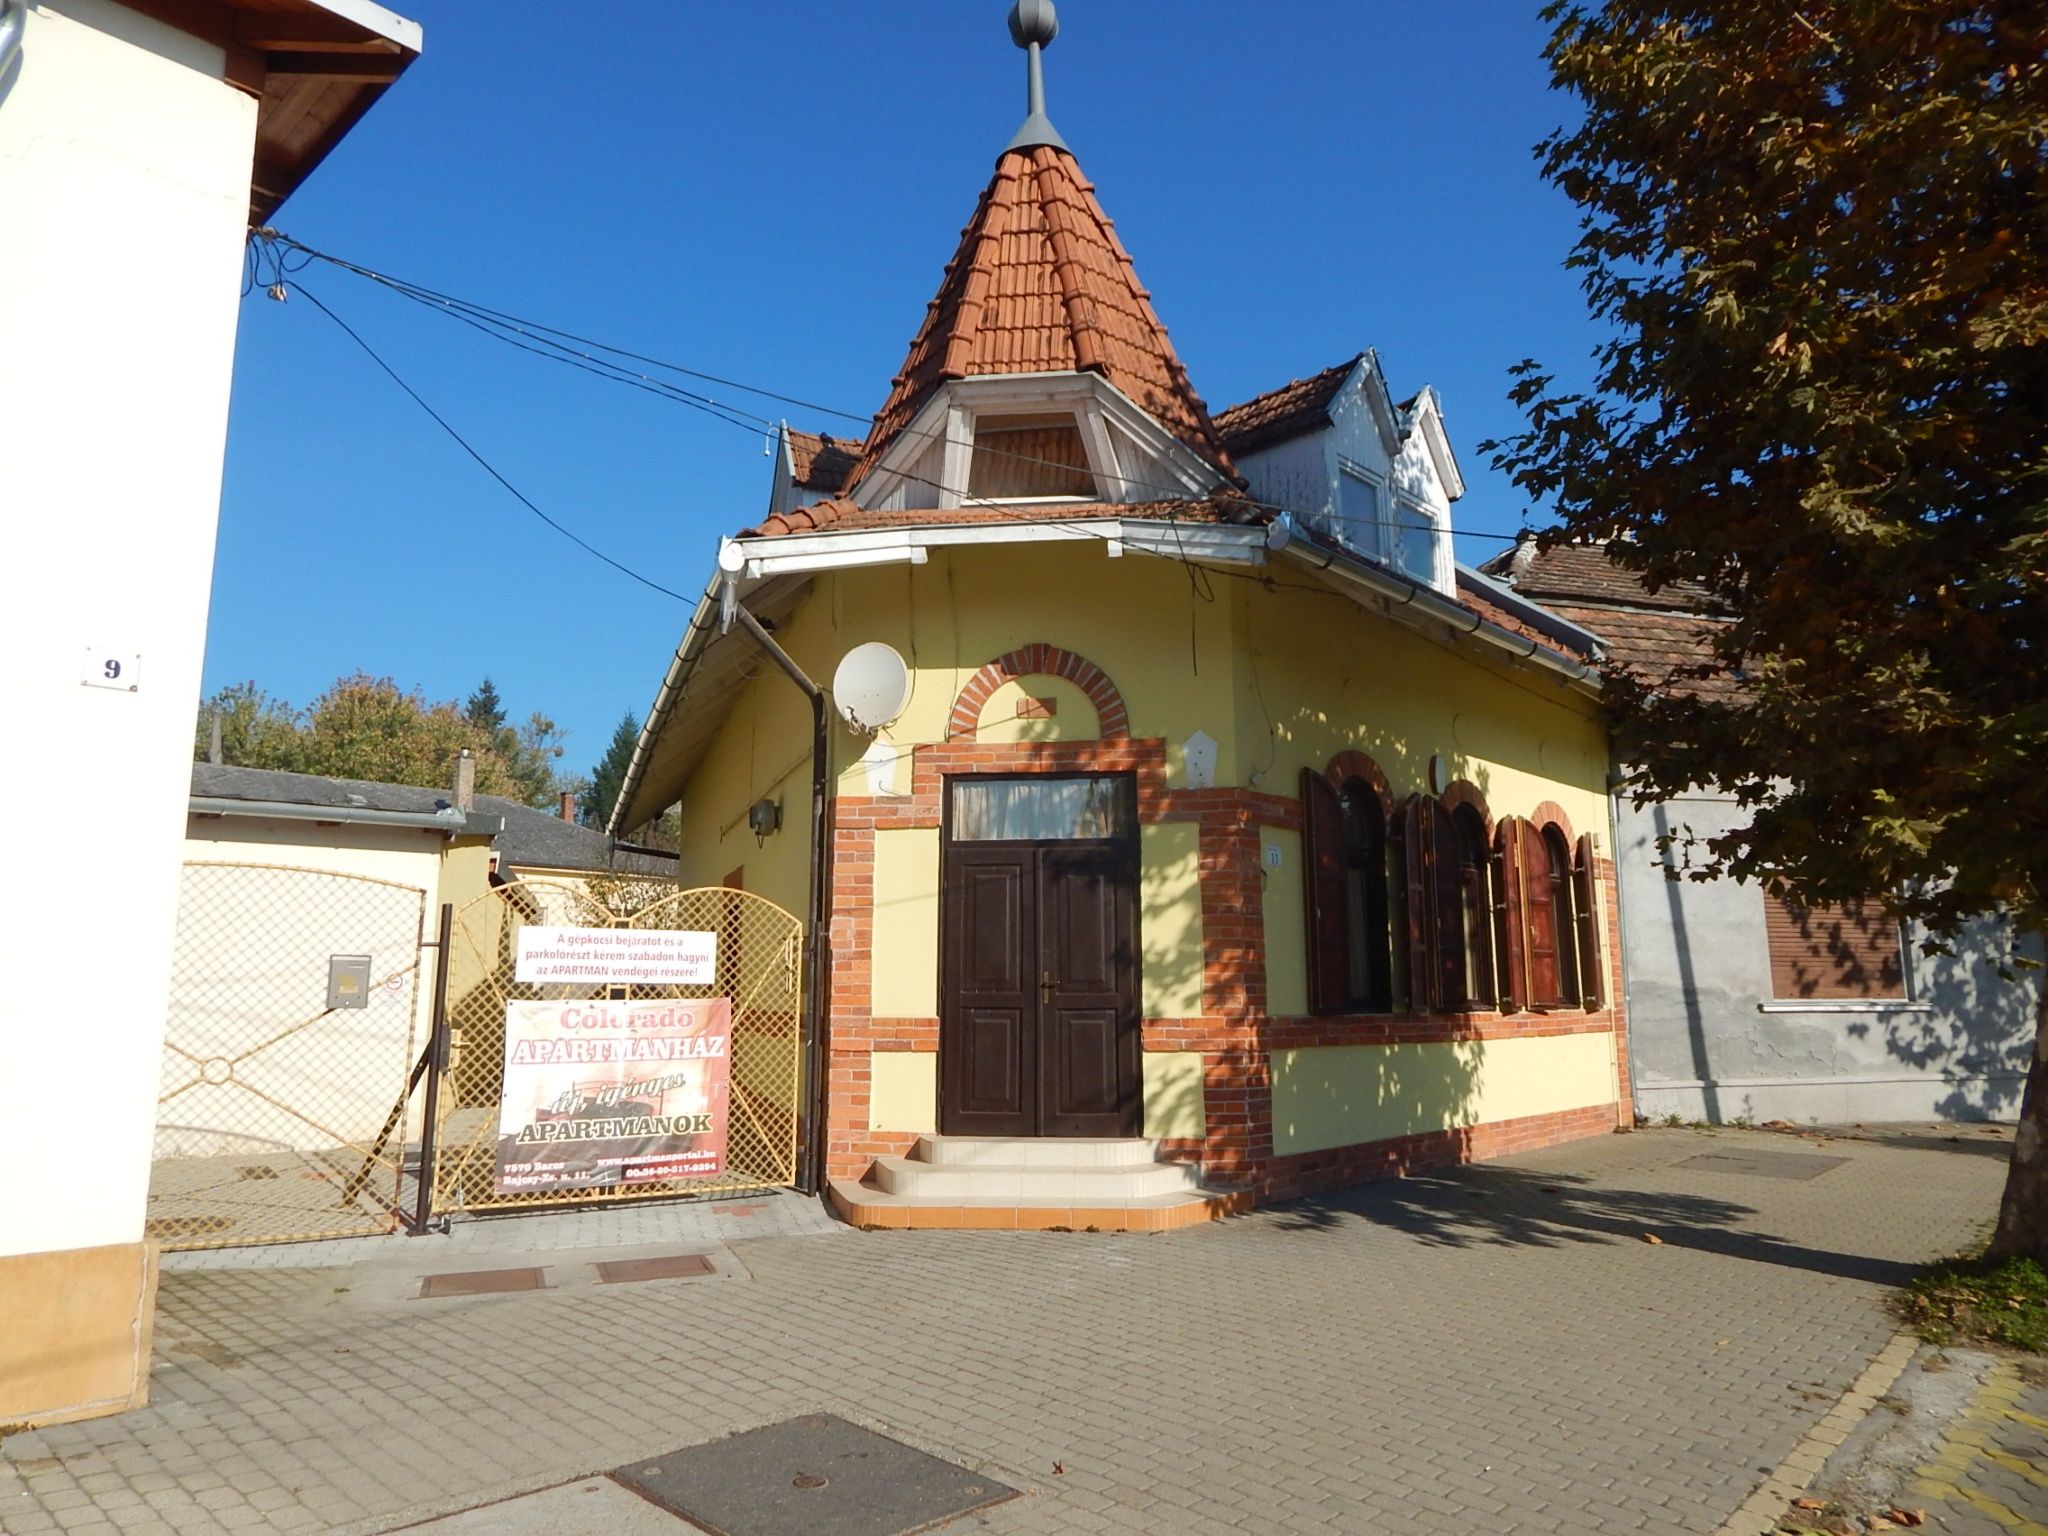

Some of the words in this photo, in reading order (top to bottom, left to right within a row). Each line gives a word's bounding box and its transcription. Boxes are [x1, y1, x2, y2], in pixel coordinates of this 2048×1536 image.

[104, 659, 121, 679] 9
[1270, 852, 1279, 865] 11
[557, 933, 565, 943] A
[568, 933, 613, 946] gépkocsi
[616, 935, 661, 948] bejáratot
[664, 936, 674, 946] és
[677, 938, 683, 946] a
[593, 950, 625, 960] kérem
[628, 951, 675, 961] szabadon
[677, 951, 709, 964] hagyni
[536, 966, 548, 975] az
[551, 965, 609, 976] APARTMAN
[612, 966, 658, 979] vendégei
[660, 967, 698, 977] részére!
[560, 1008, 694, 1030] Colorado
[511, 1029, 725, 1065] APARTMANHÁZ
[596, 1073, 686, 1107] igényes
[517, 1113, 714, 1144] APARTMANOK
